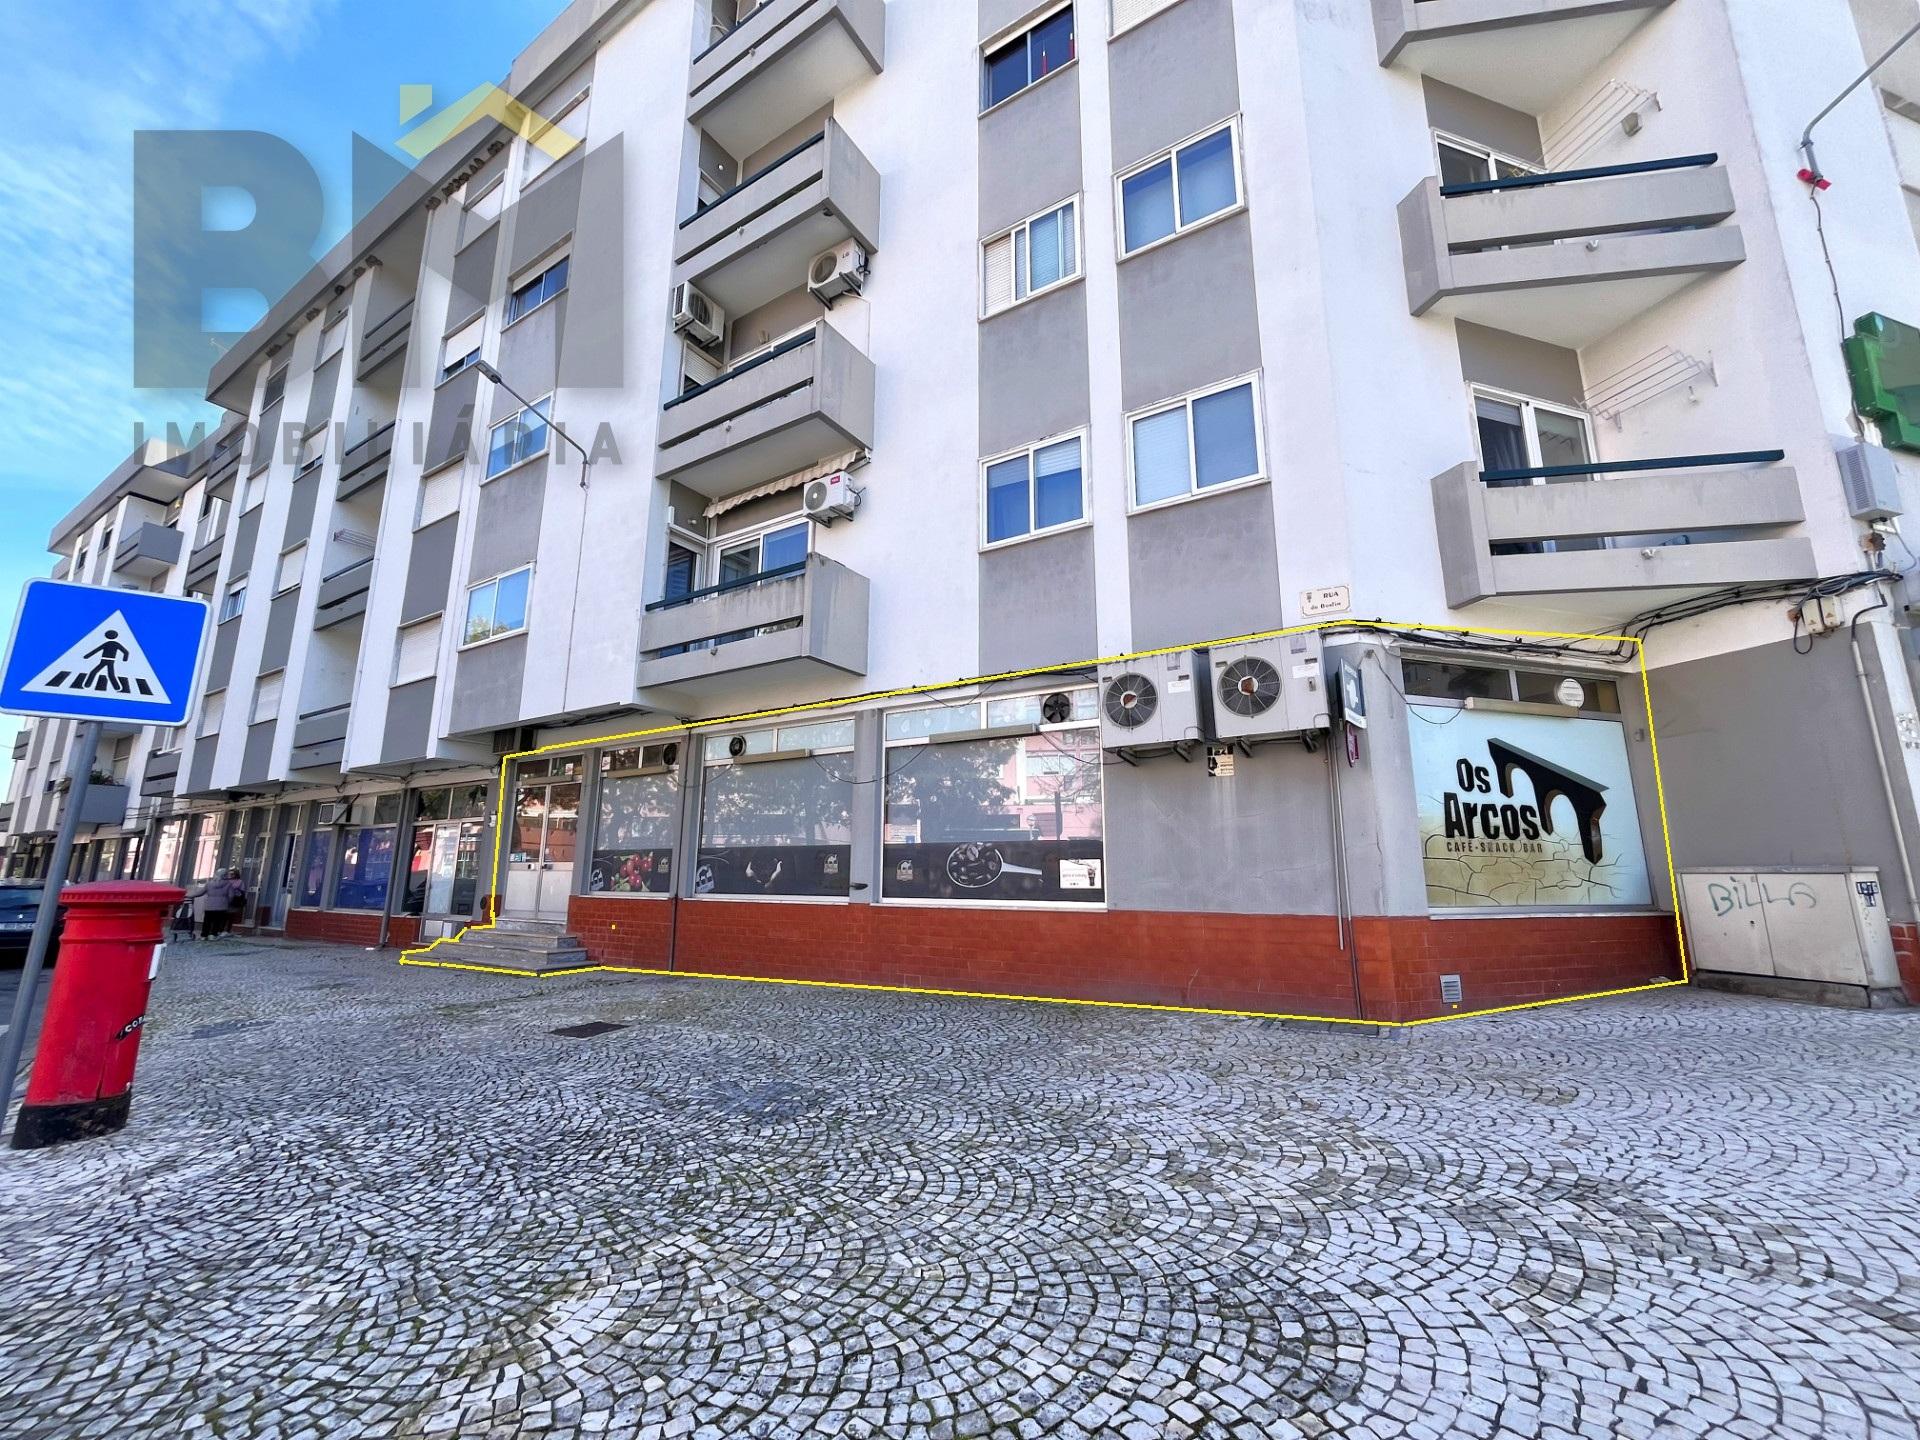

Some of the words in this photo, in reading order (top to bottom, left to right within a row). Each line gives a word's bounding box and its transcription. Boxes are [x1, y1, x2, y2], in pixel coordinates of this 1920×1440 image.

[1323, 591, 1339, 599] RUA
[1456, 758, 1492, 794] Os
[1443, 792, 1540, 841] Arcos
